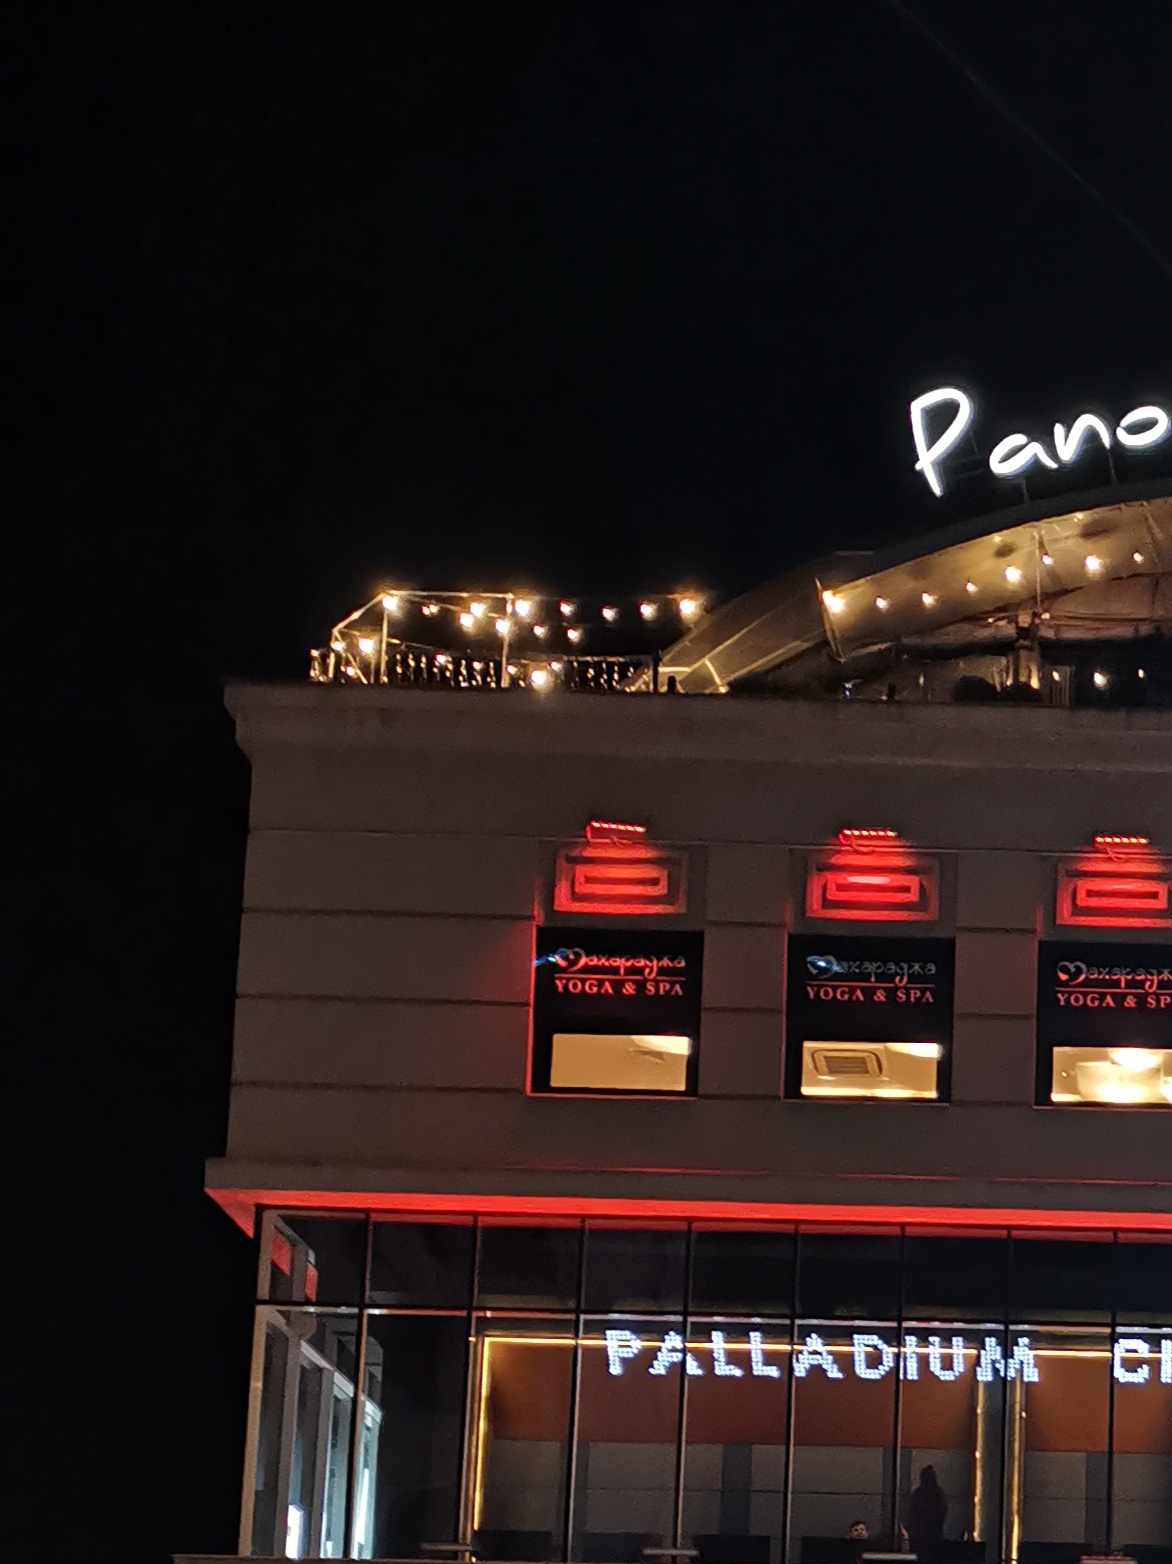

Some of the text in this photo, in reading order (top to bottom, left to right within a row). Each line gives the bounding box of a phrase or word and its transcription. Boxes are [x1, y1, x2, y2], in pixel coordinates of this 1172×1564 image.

[555, 979, 683, 996] YOGA & SPA
[806, 986, 934, 1003] YOGA & SPA
[1056, 993, 1116, 1008] YOGA
[1123, 995, 1137, 1008] &
[604, 1328, 1040, 1384] PALLADIUM
